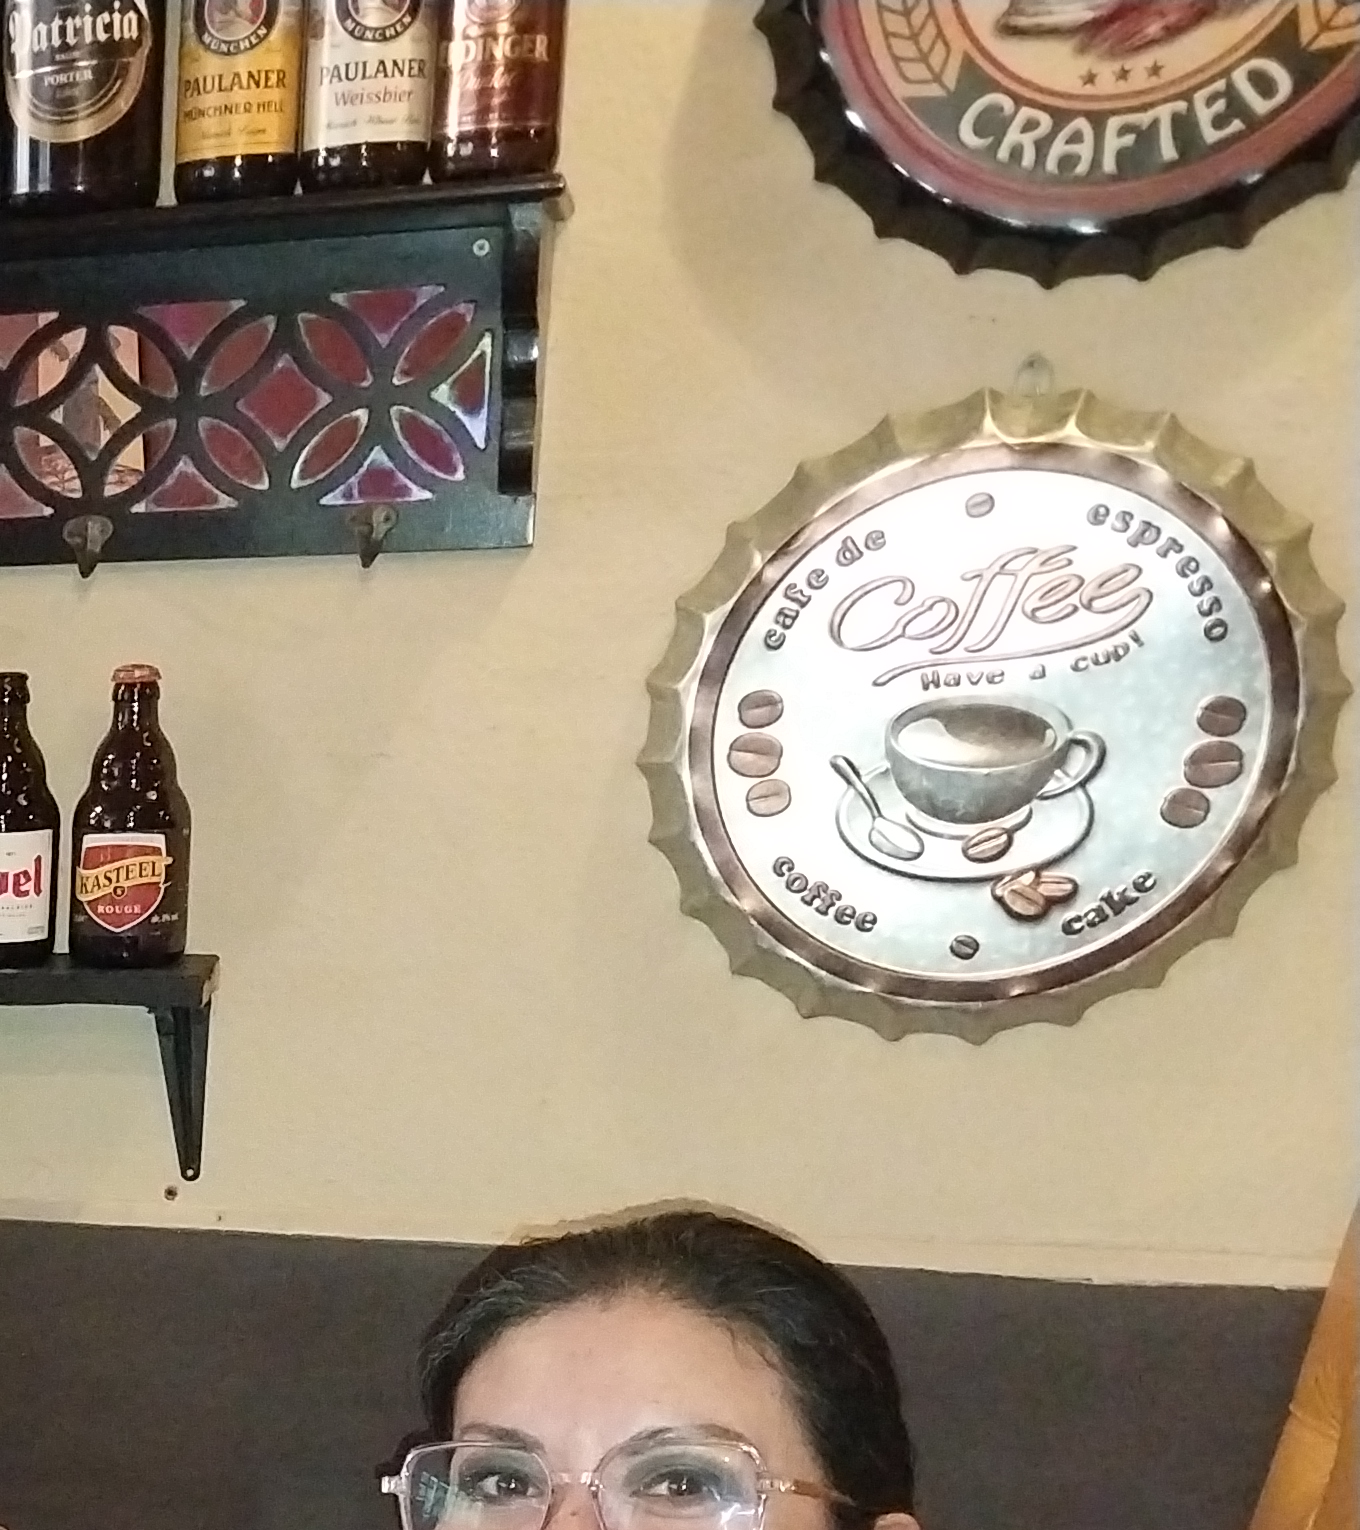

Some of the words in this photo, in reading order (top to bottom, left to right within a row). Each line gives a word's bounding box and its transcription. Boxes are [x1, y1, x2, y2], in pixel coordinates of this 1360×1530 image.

[9, 0, 139, 54] Patricia
[201, 24, 269, 54] MÜNCHEN
[344, 15, 414, 41] MÜNCHEN
[43, 69, 93, 87] PORTER
[183, 69, 287, 98] PAULANER
[320, 58, 428, 86] PAULANER
[334, 85, 414, 107] Weissbier
[957, 57, 1294, 178] CRAFTED
[764, 565, 829, 651] cafe
[835, 526, 887, 567] de
[1087, 502, 1229, 643] espresso
[828, 544, 1154, 660] Coffee
[920, 666, 1005, 692] Have
[1028, 663, 1047, 681] a
[1069, 630, 1146, 676] cup!
[79, 860, 162, 895] KASTEEL
[771, 855, 879, 934] coffee
[97, 904, 142, 915] ROUGE
[1060, 869, 1159, 938] cake
